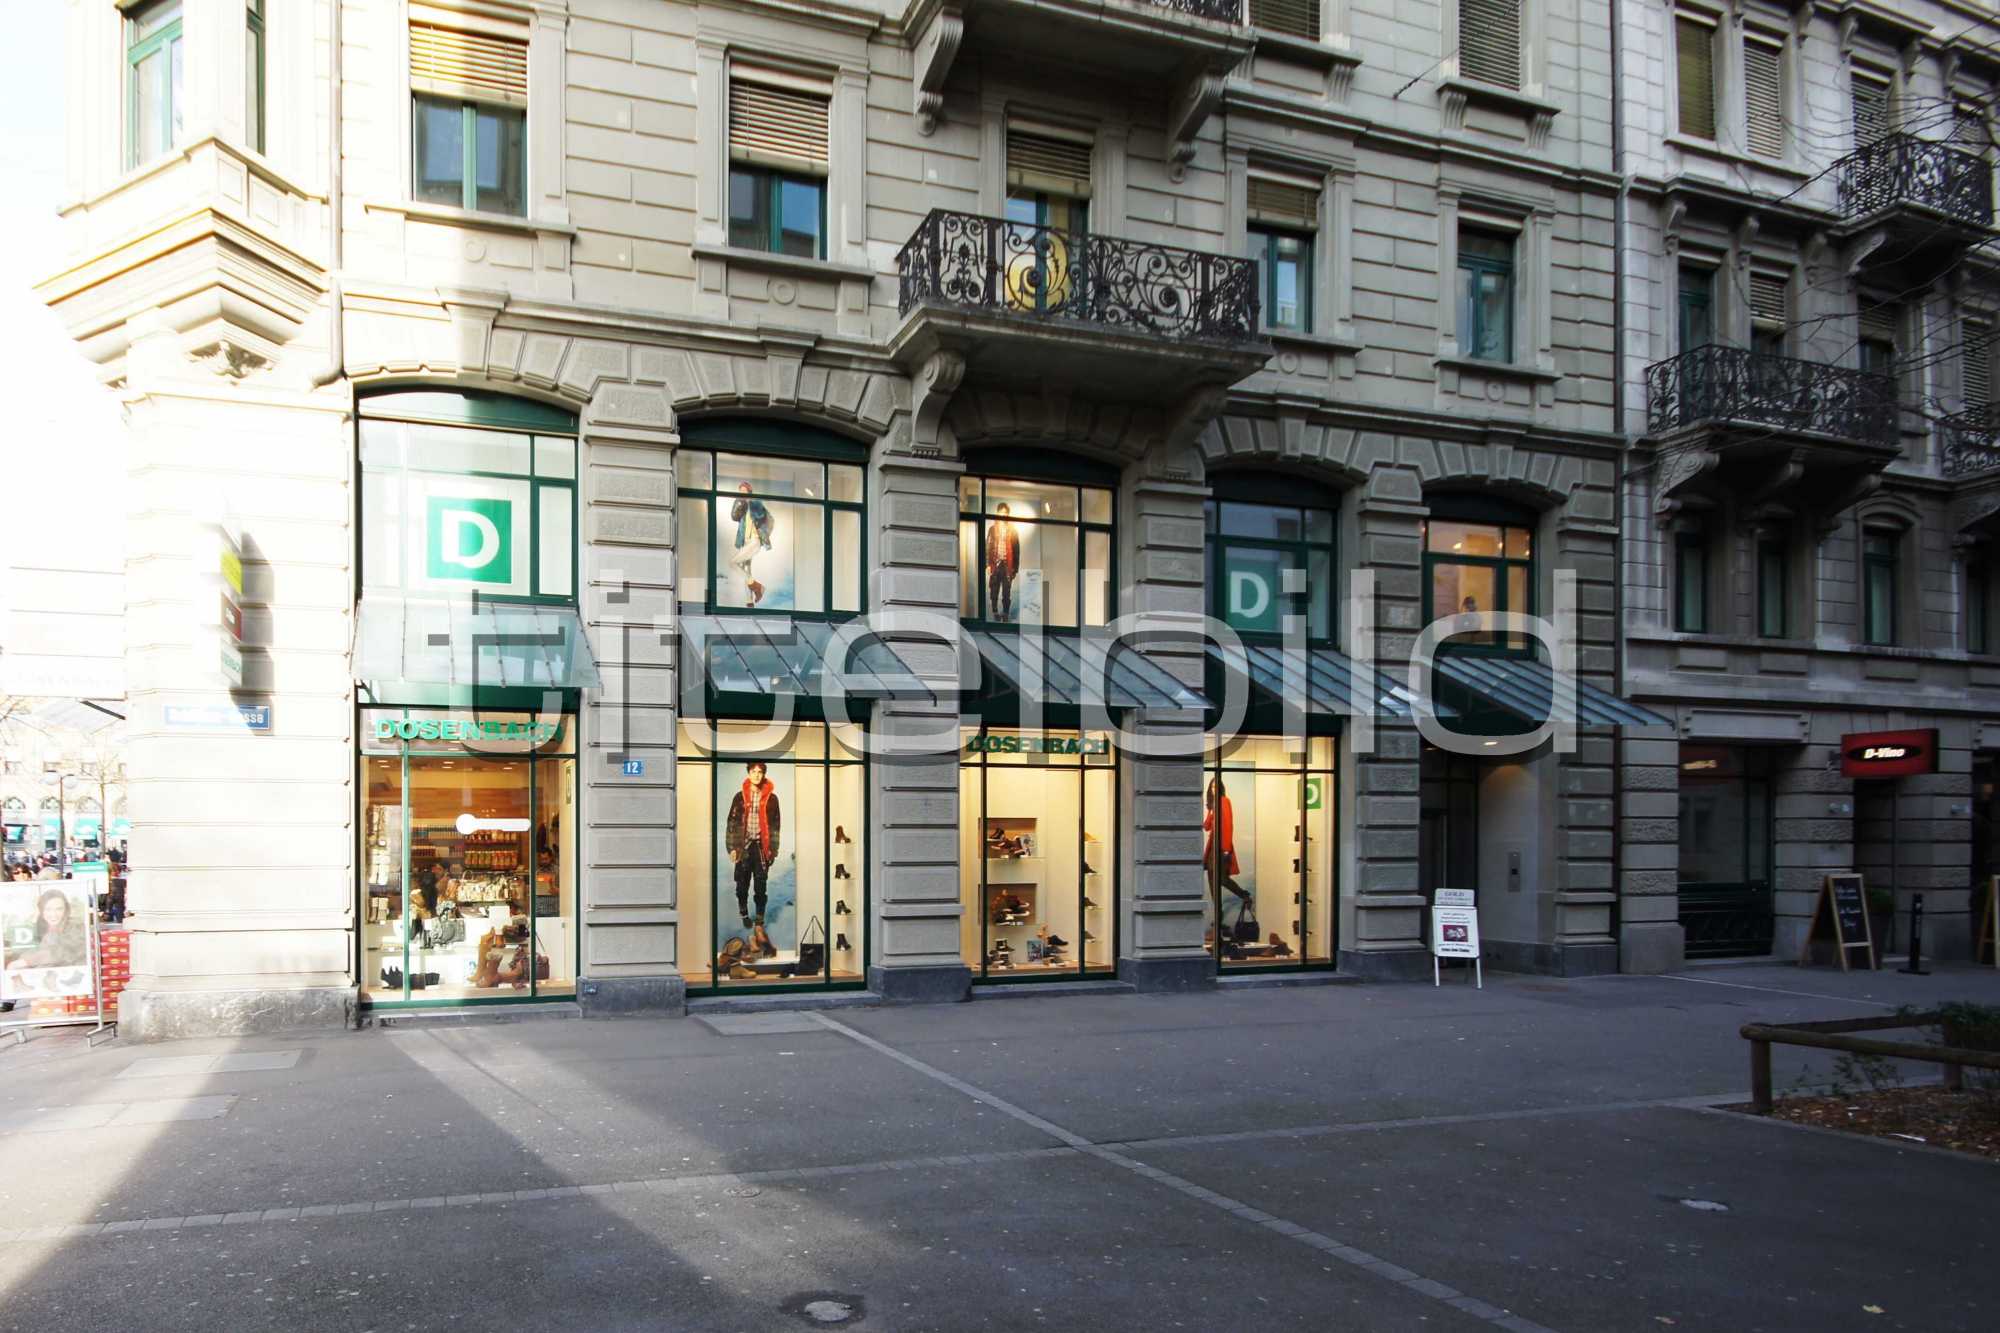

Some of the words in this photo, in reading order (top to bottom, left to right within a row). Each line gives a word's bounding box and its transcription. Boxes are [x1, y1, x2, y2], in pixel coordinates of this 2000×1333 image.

[442, 510, 500, 568] D
[1230, 571, 1269, 618] D
[375, 719, 563, 742] DOSENBACH
[967, 735, 1110, 755] DOSENBACH
[627, 761, 639, 774] 12
